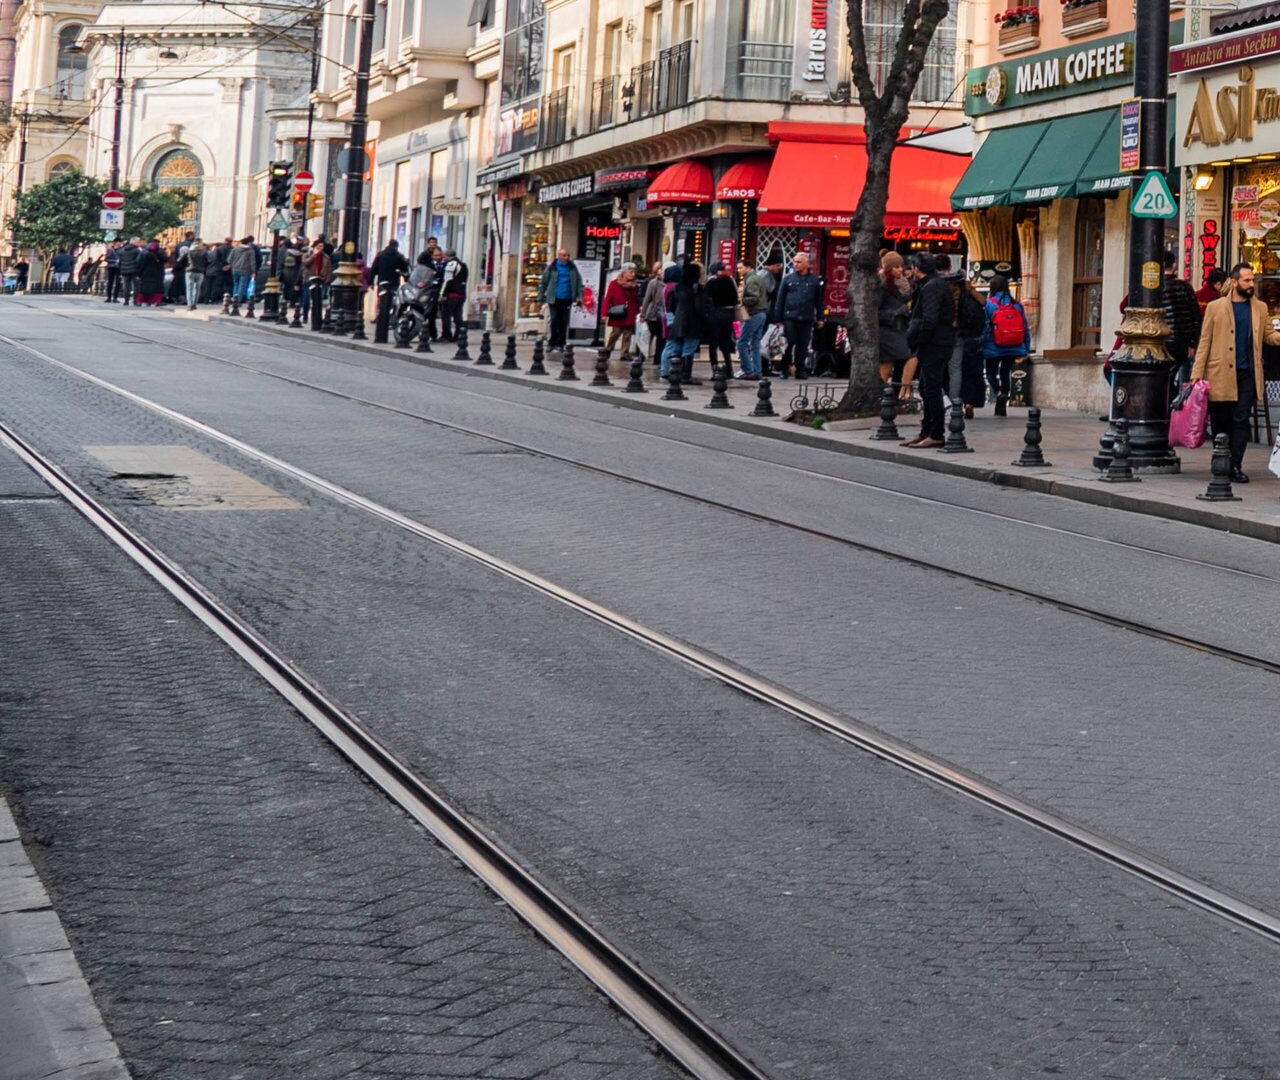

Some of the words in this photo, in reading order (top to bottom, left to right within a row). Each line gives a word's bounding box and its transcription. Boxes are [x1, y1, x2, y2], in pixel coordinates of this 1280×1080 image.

[1015, 58, 1060, 94] MAM
[1065, 42, 1126, 84] COFFEE
[538, 180, 570, 204] STARBUCKS
[571, 176, 592, 195] COFFEE
[722, 187, 755, 197] FAROS
[1143, 193, 1165, 210] 20
[586, 225, 620, 238] Hotel
